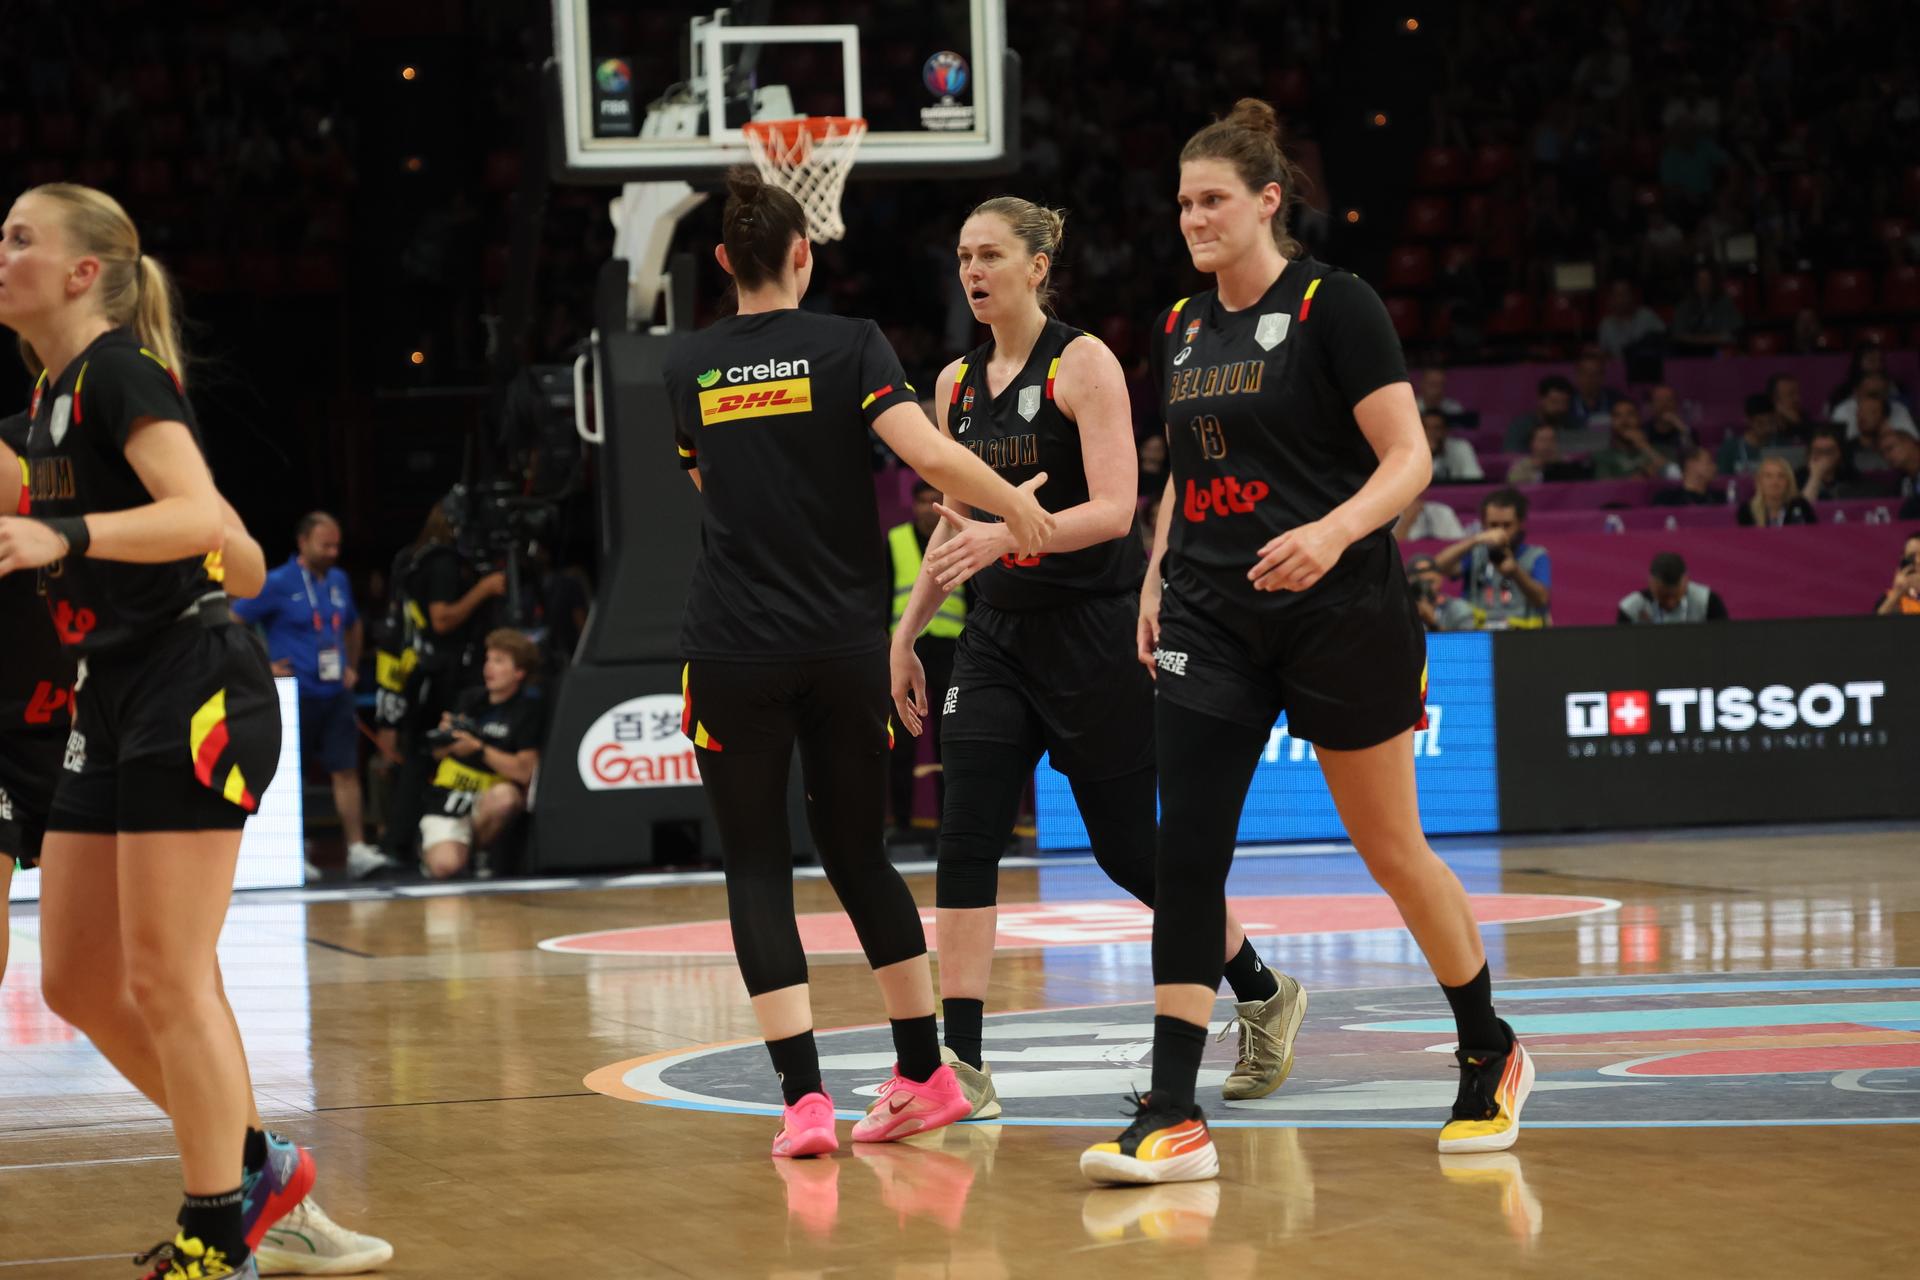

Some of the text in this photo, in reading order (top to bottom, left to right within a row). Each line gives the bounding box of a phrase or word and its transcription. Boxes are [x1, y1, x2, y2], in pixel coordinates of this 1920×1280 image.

[726, 359, 810, 383] crelan
[1169, 360, 1265, 404] BELGIUM
[717, 389, 792, 413] DHL
[1190, 414, 1227, 460] 13
[1656, 680, 1885, 733] TISSOT
